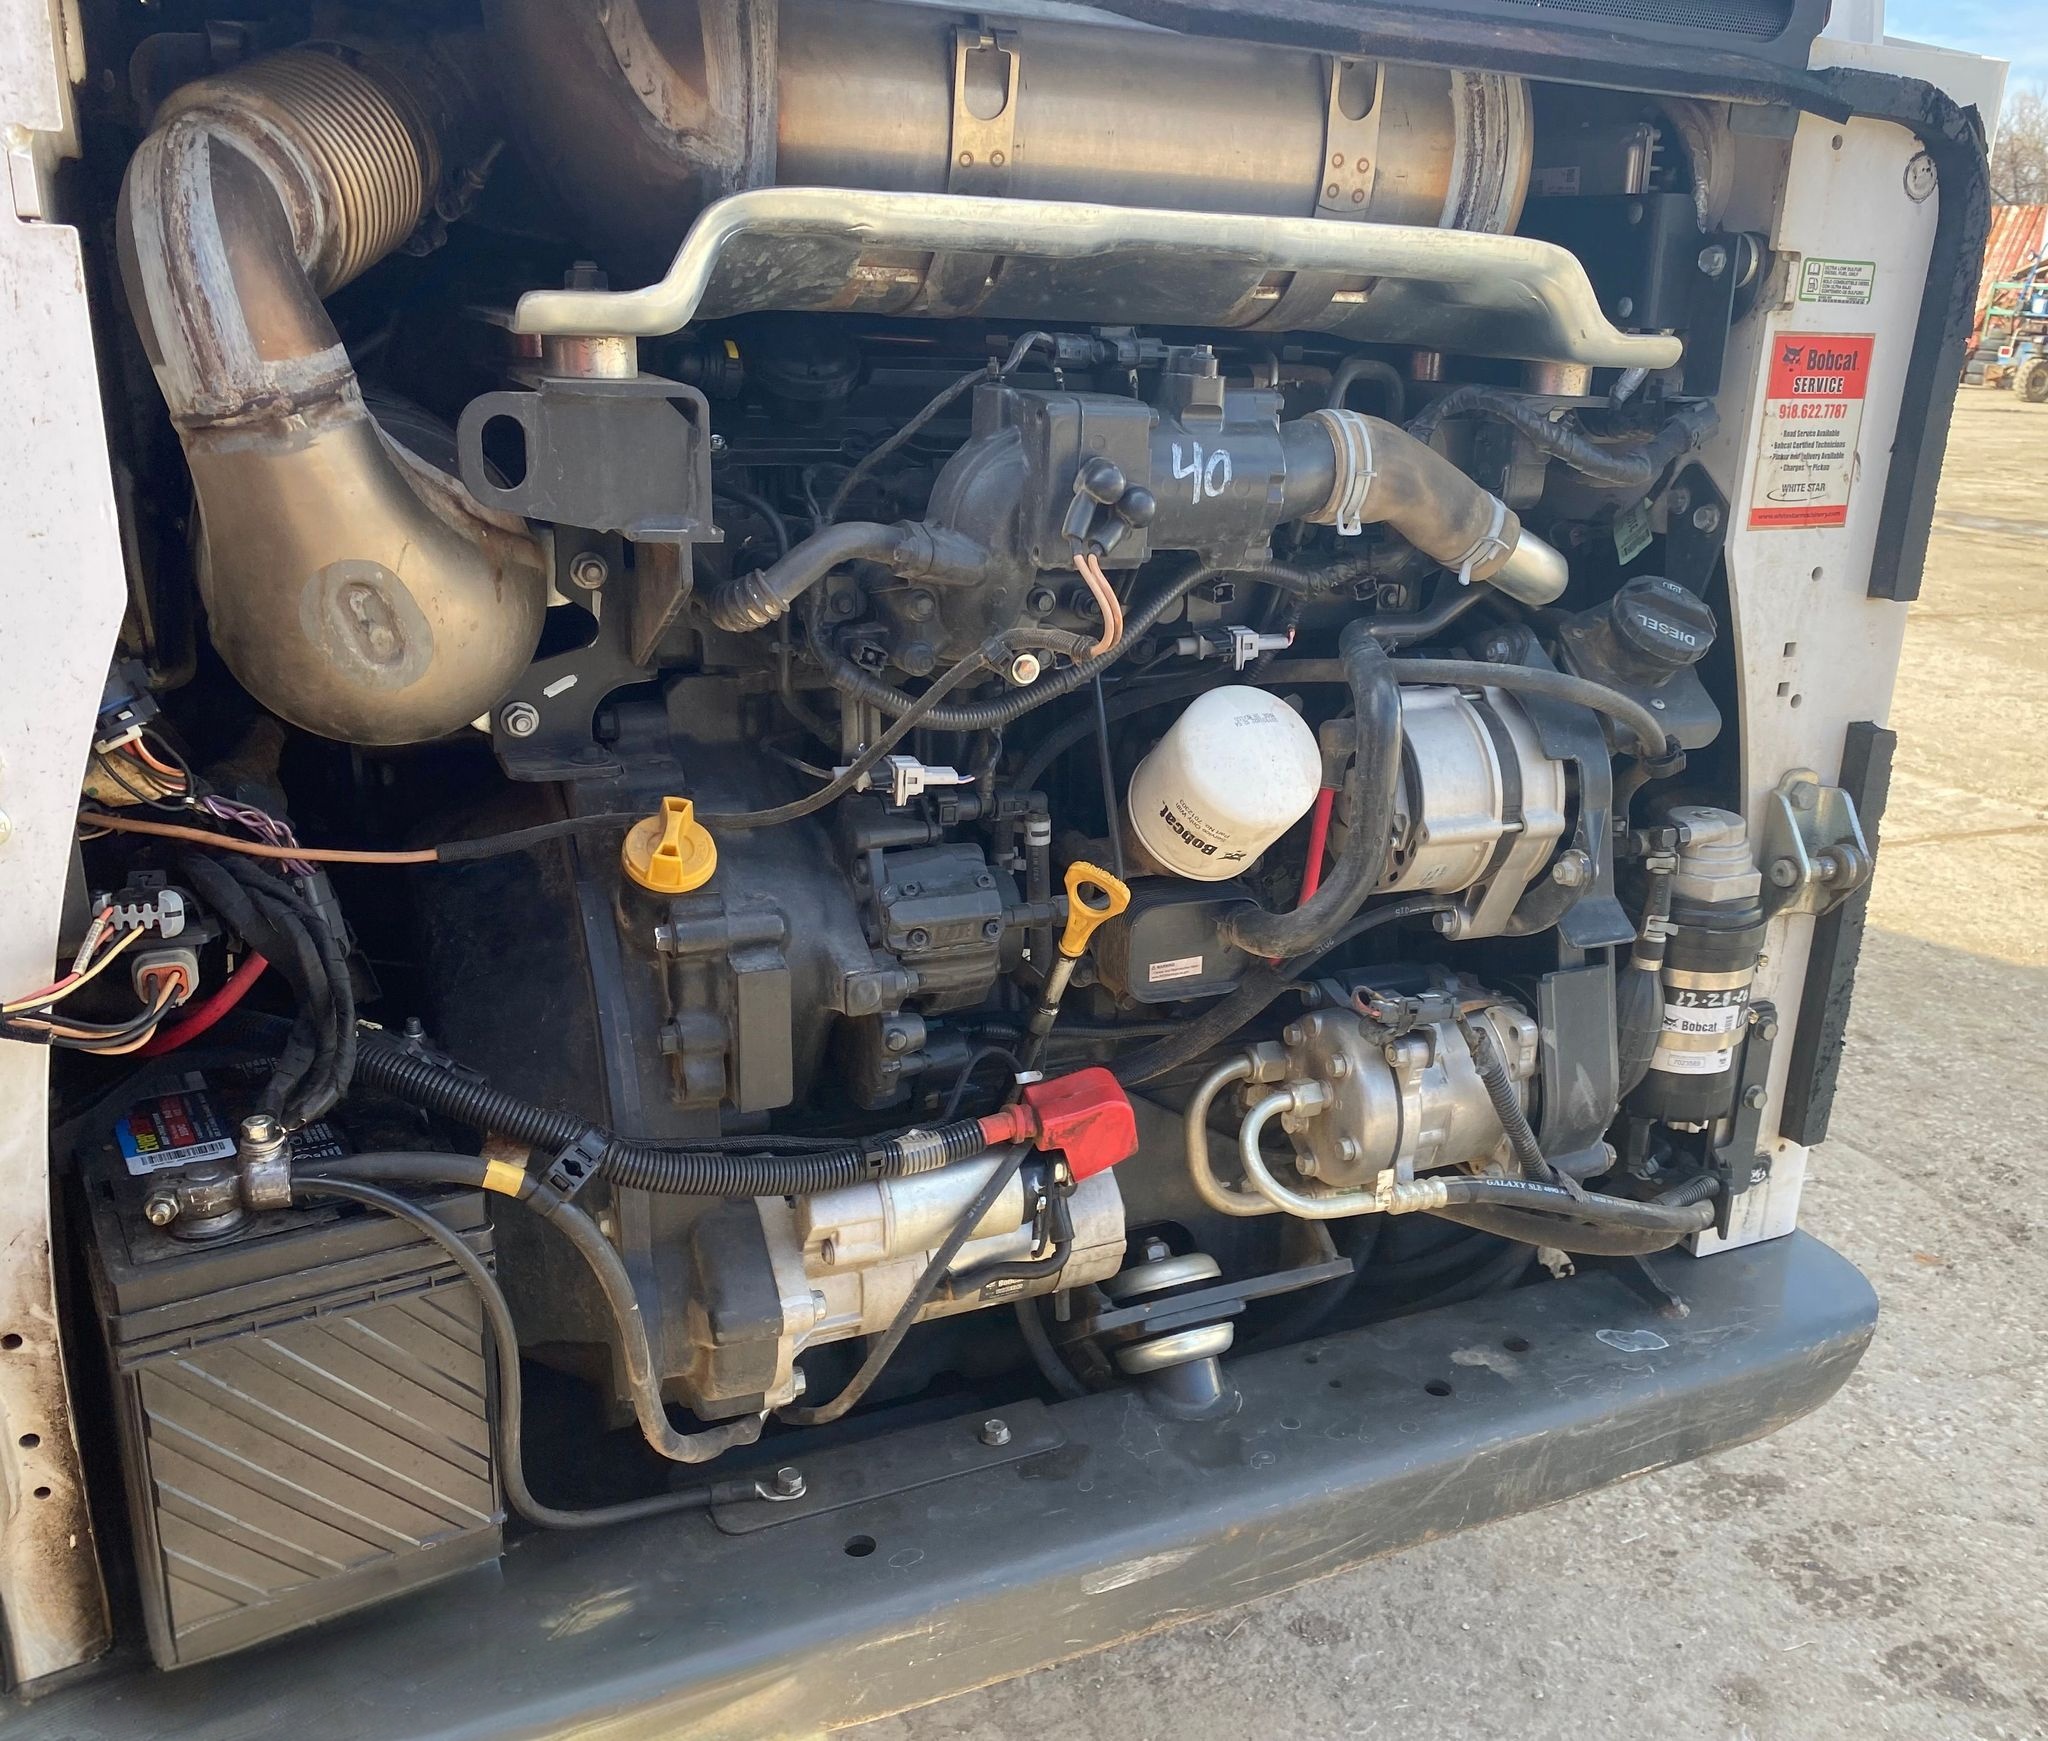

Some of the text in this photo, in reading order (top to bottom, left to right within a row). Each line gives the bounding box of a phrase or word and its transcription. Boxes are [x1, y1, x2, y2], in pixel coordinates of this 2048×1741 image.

[1807, 349, 1858, 371] Bobcat
[1793, 377, 1844, 393] SERVICE
[1779, 403, 1848, 419] 918.622.7787
[1816, 429, 1840, 437] Available
[1774, 441, 1846, 449] Bobcat Certified Technicians
[1172, 441, 1232, 505] 40
[1782, 482, 1826, 493] WHITE STAR
[1637, 614, 1696, 647] DIESEL
[1160, 804, 1218, 856] Bobcat
[1682, 1020, 1718, 1033] Bobcat
[1486, 1179, 1527, 1189] GALAXY
